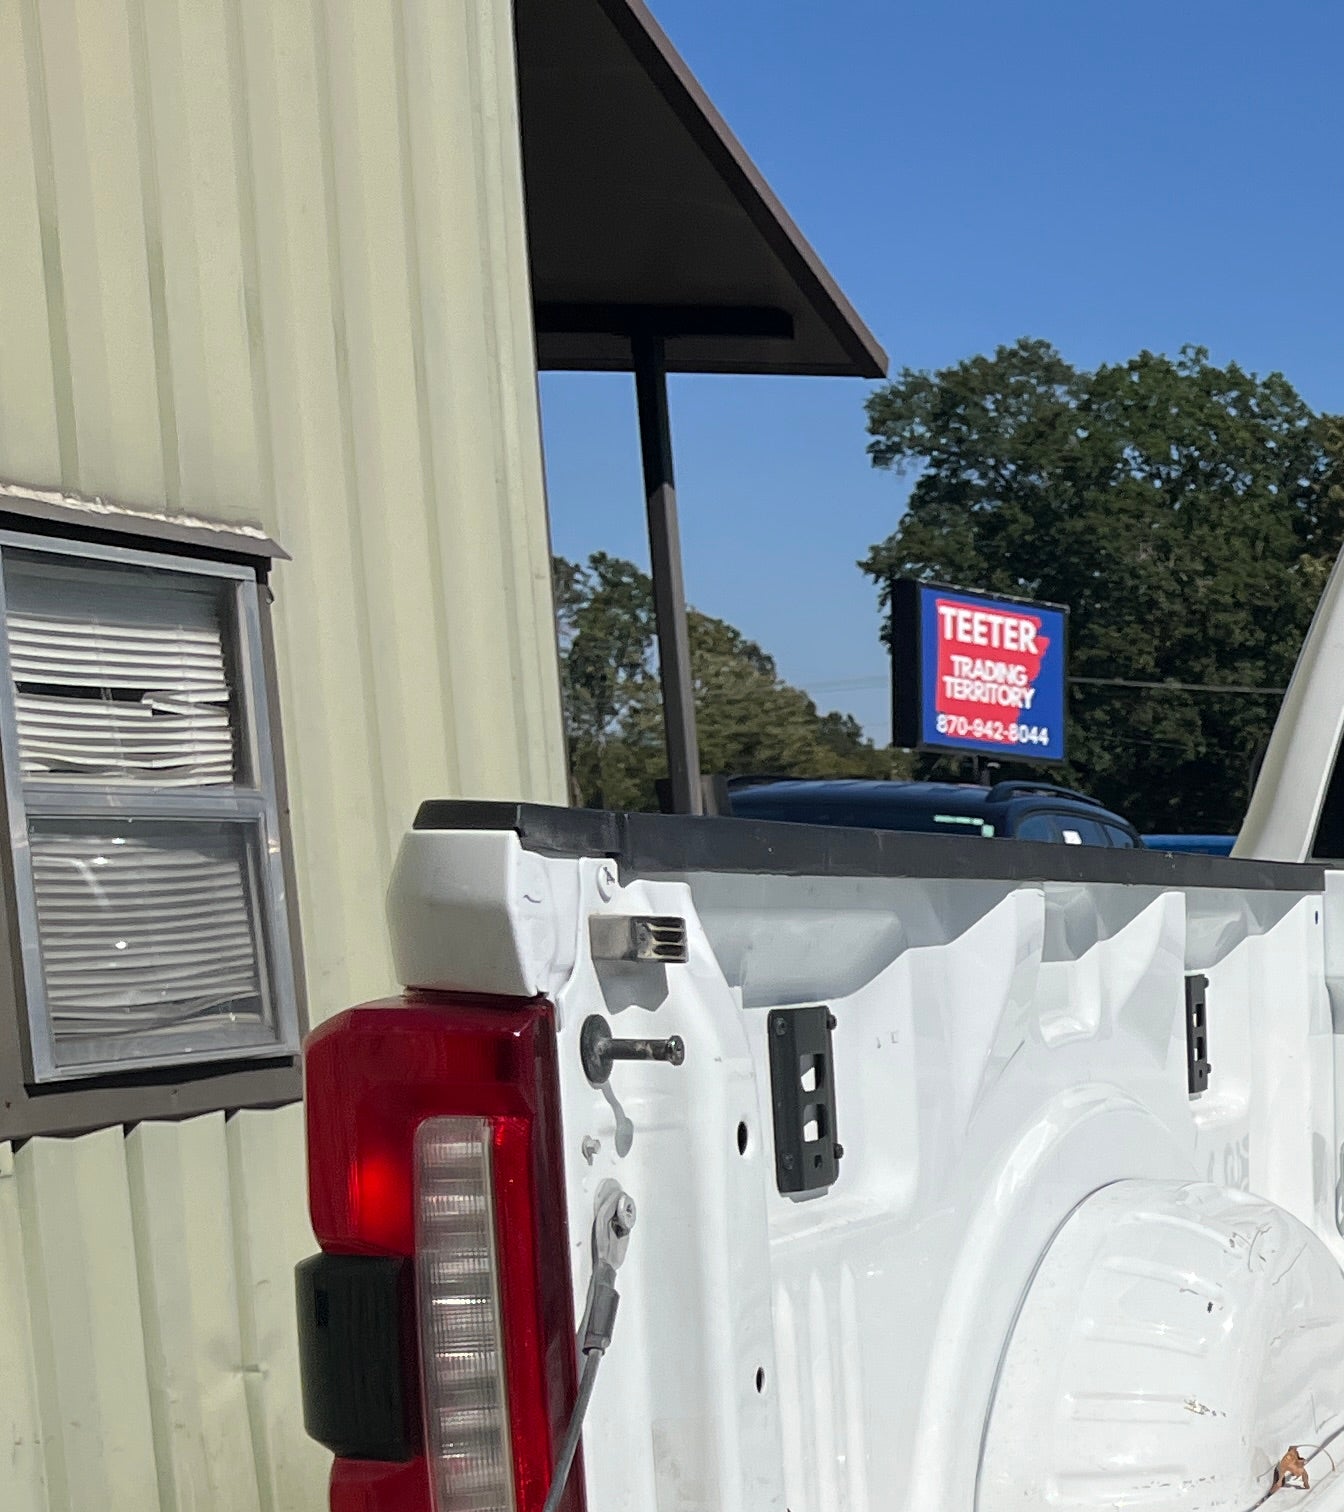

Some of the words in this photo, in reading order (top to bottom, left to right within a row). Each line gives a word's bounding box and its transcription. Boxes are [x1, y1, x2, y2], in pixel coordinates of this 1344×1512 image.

[938, 605, 1038, 654] TEETER
[950, 654, 1028, 686] TRADING
[943, 675, 1035, 709] TERRITORY
[936, 714, 1049, 746] 870-942-8044
